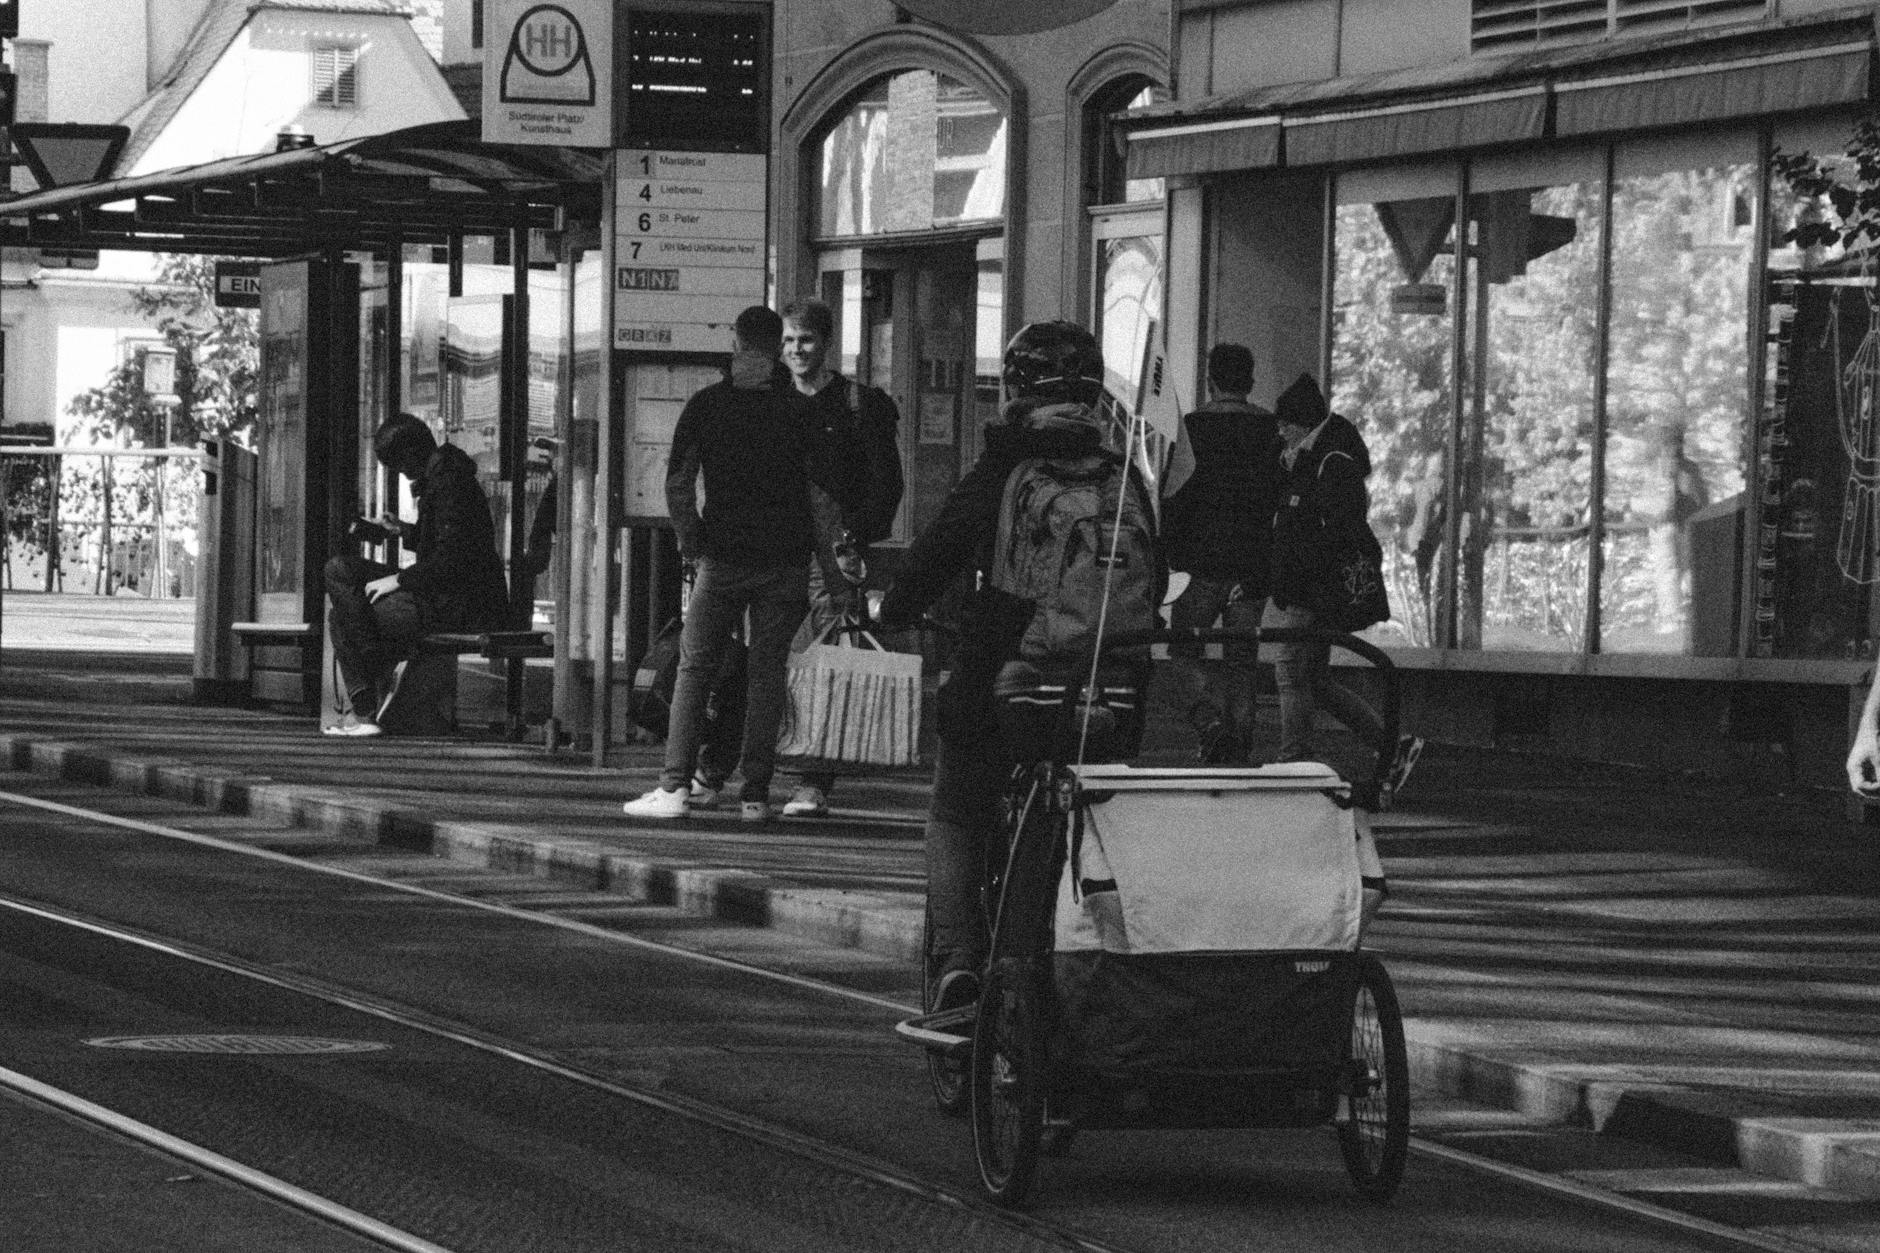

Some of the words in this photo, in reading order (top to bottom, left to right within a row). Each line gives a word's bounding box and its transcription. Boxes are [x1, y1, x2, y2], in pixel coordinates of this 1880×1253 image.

[520, 123, 572, 134] Kunsthaus
[640, 156, 649, 174] 1
[639, 184, 651, 202] 4
[660, 185, 702, 195] Liebenau
[638, 213, 651, 232] 6
[674, 214, 700, 224] Peter
[631, 242, 642, 259] 7
